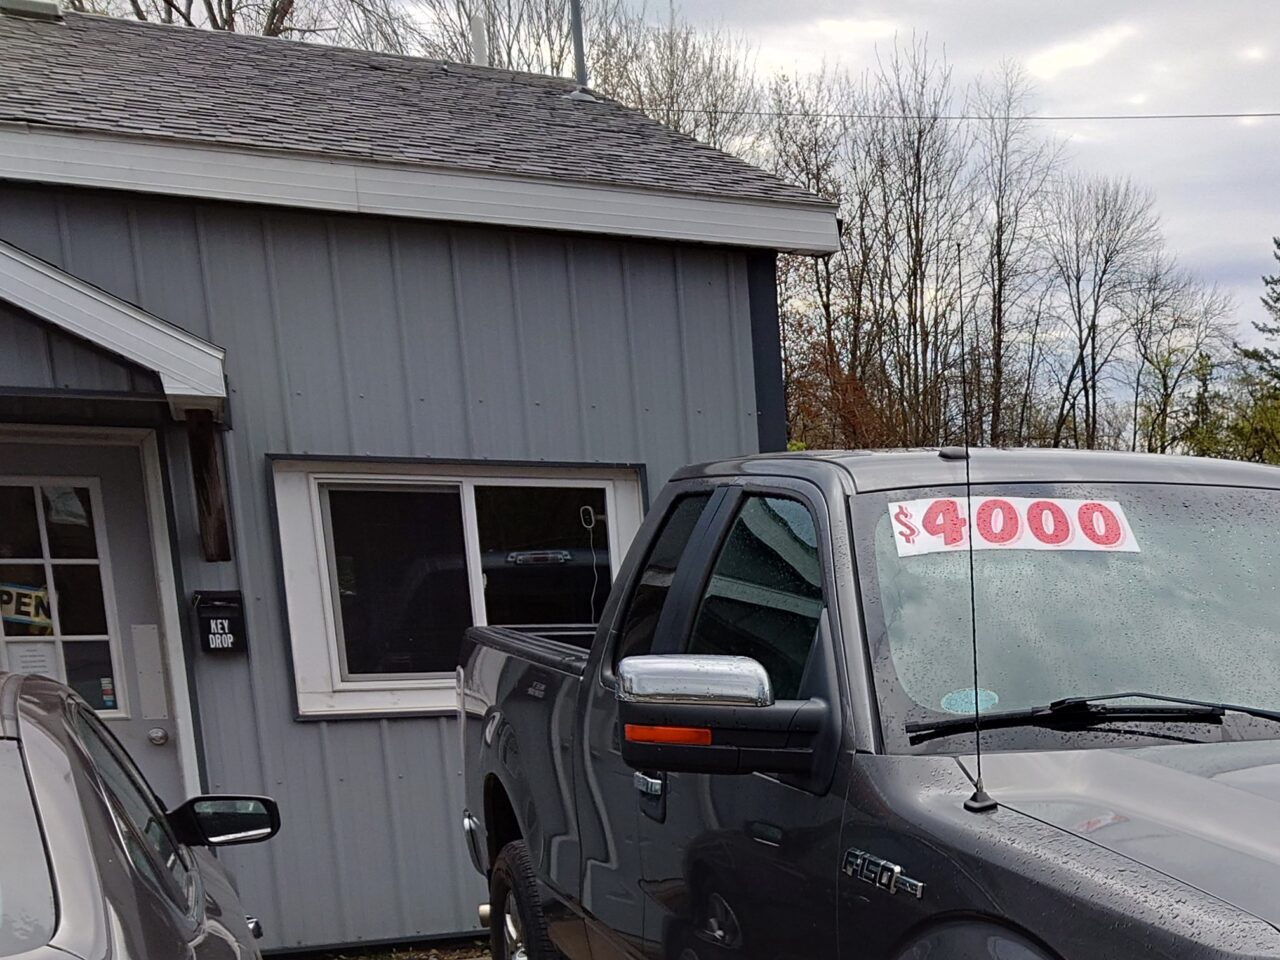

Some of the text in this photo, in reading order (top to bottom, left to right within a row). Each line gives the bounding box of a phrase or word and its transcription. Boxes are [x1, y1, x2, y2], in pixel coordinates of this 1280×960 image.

[894, 499, 1124, 547] $4000
[210, 619, 229, 633] KEY
[208, 634, 234, 648] DROP
